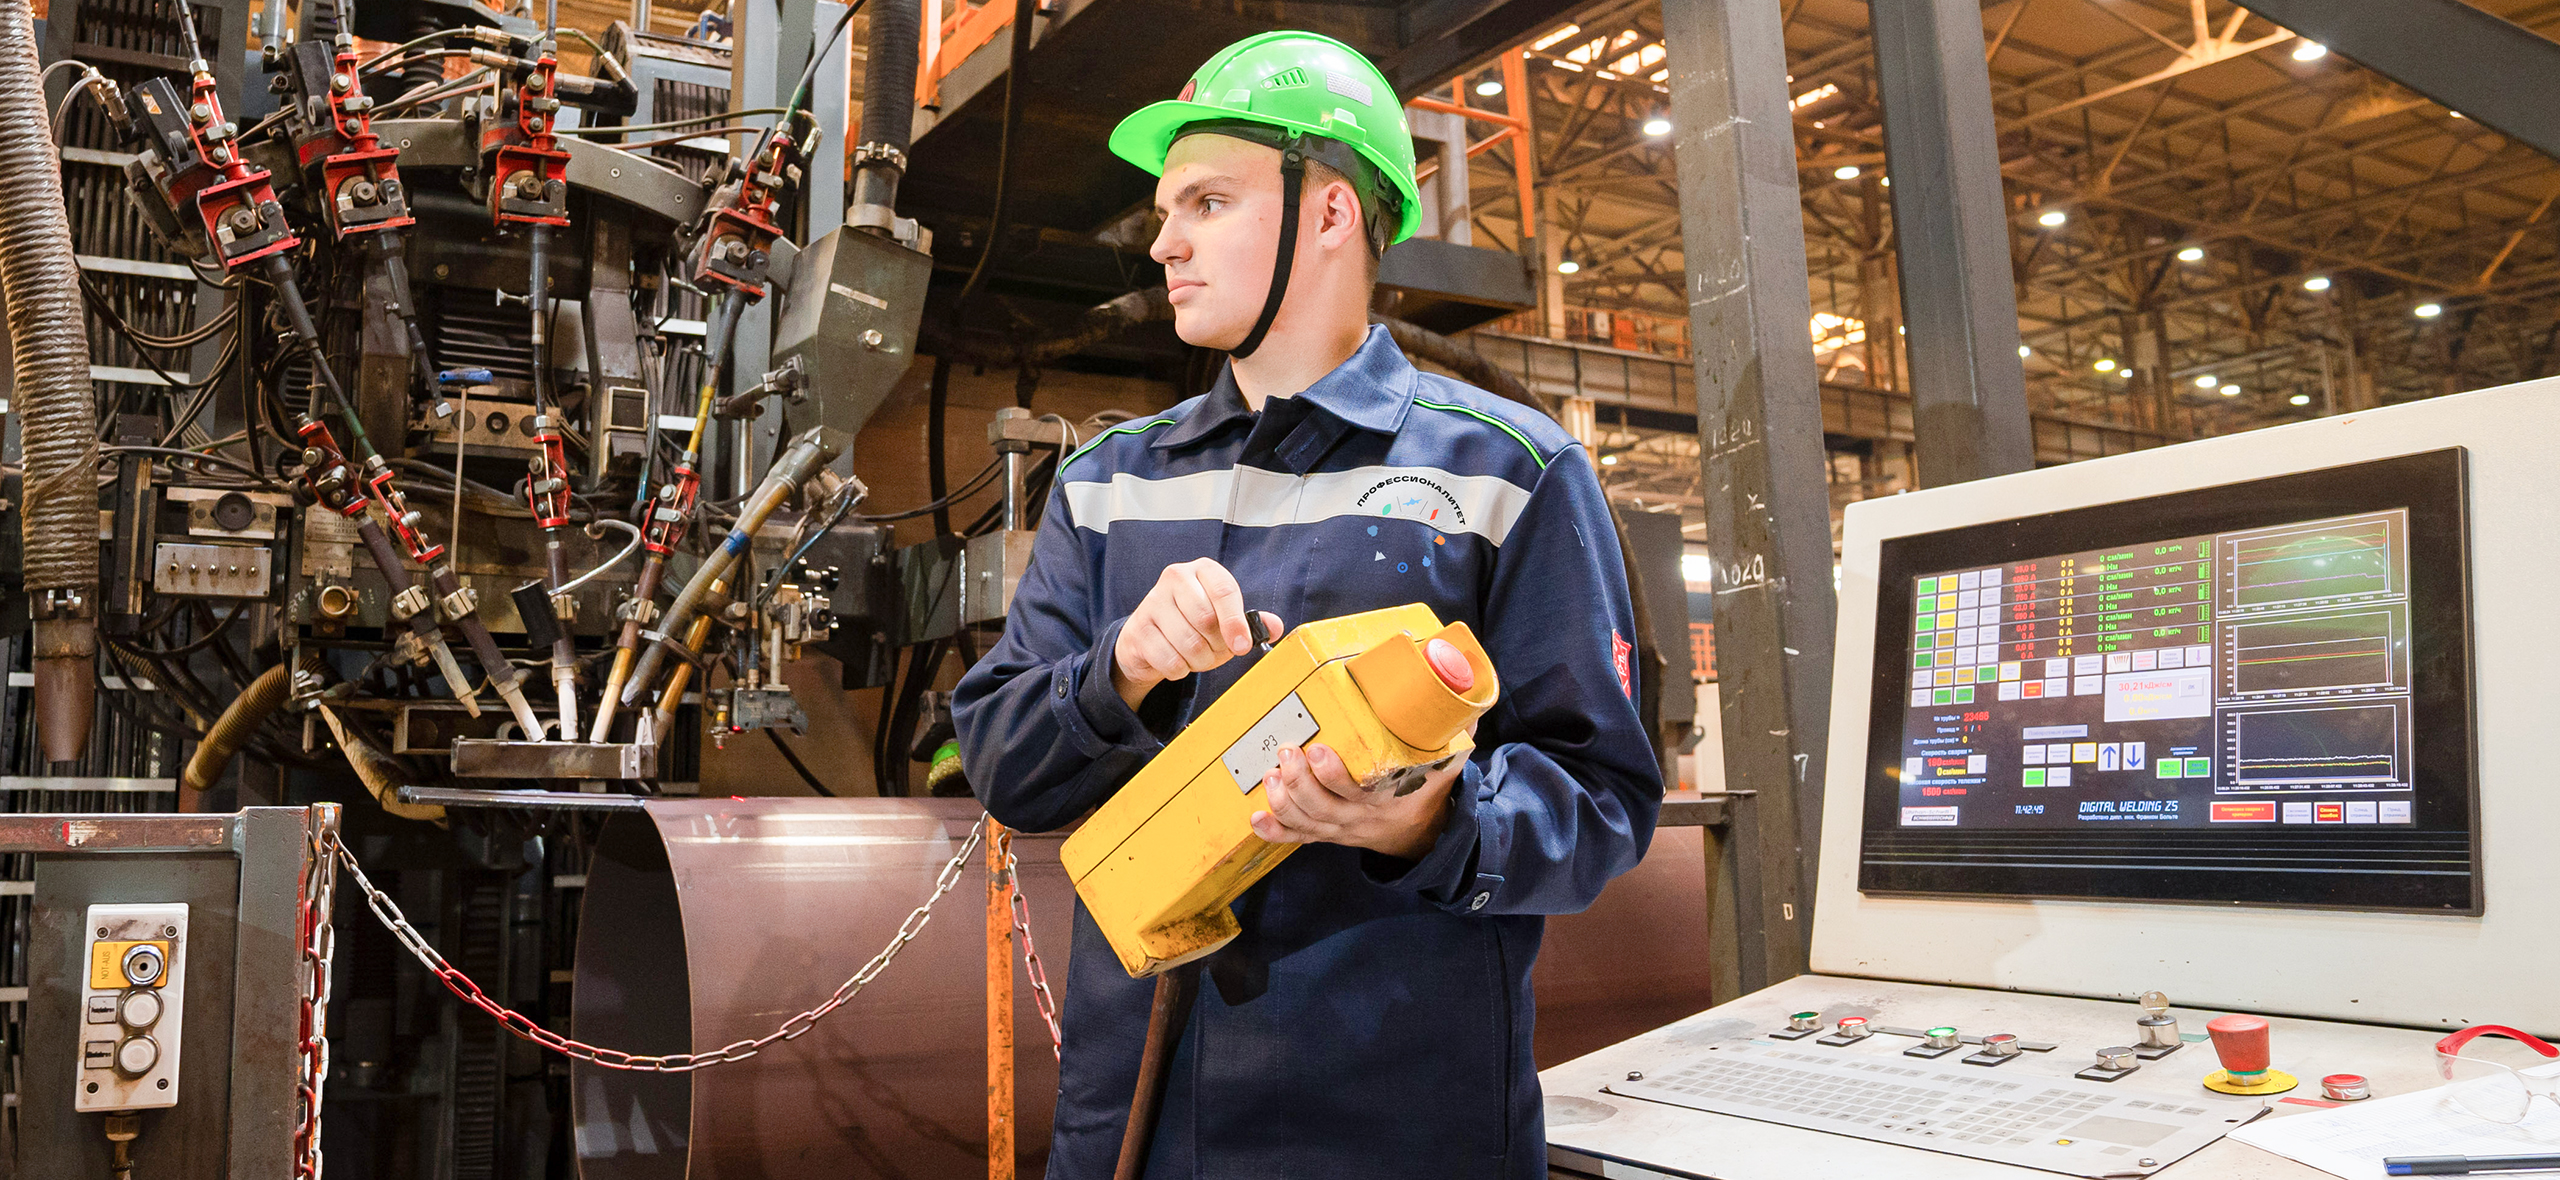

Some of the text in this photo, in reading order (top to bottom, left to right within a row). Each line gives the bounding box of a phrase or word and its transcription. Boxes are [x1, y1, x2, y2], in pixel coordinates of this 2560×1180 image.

[1356, 476, 1466, 526] ПРОФЕССИОНАЛИТЕТ
[1262, 735, 1278, 751] +P3
[1793, 753, 1809, 782] 7
[2015, 804, 2043, 814] 11:42:49
[2079, 801, 2116, 813] DIGITAL
[2119, 800, 2162, 812] WELDING
[101, 951, 110, 980] NOT-AUS
